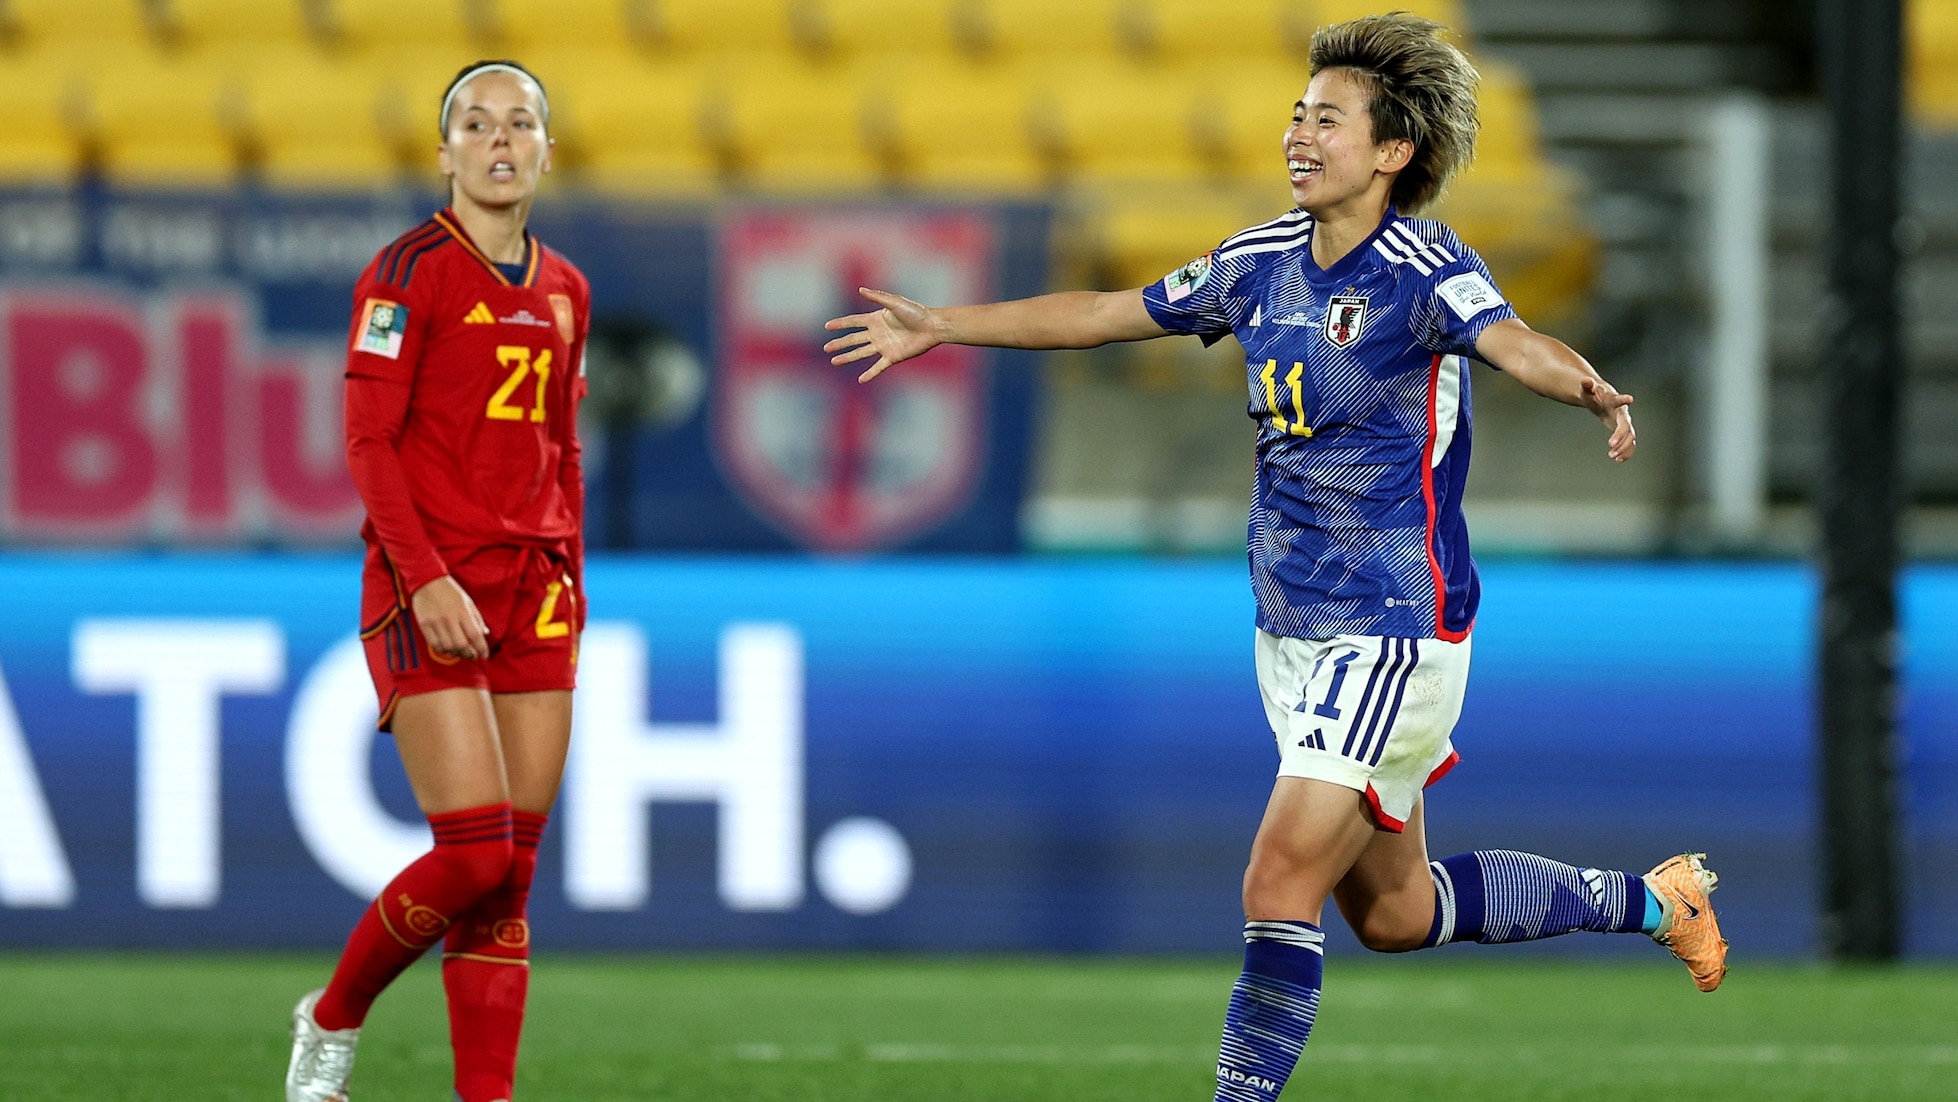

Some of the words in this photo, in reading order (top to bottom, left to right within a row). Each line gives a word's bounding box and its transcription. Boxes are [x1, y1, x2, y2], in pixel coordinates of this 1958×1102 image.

[1454, 284, 1481, 298] UNITES
[485, 345, 553, 423] 21
[1259, 358, 1313, 438] 11
